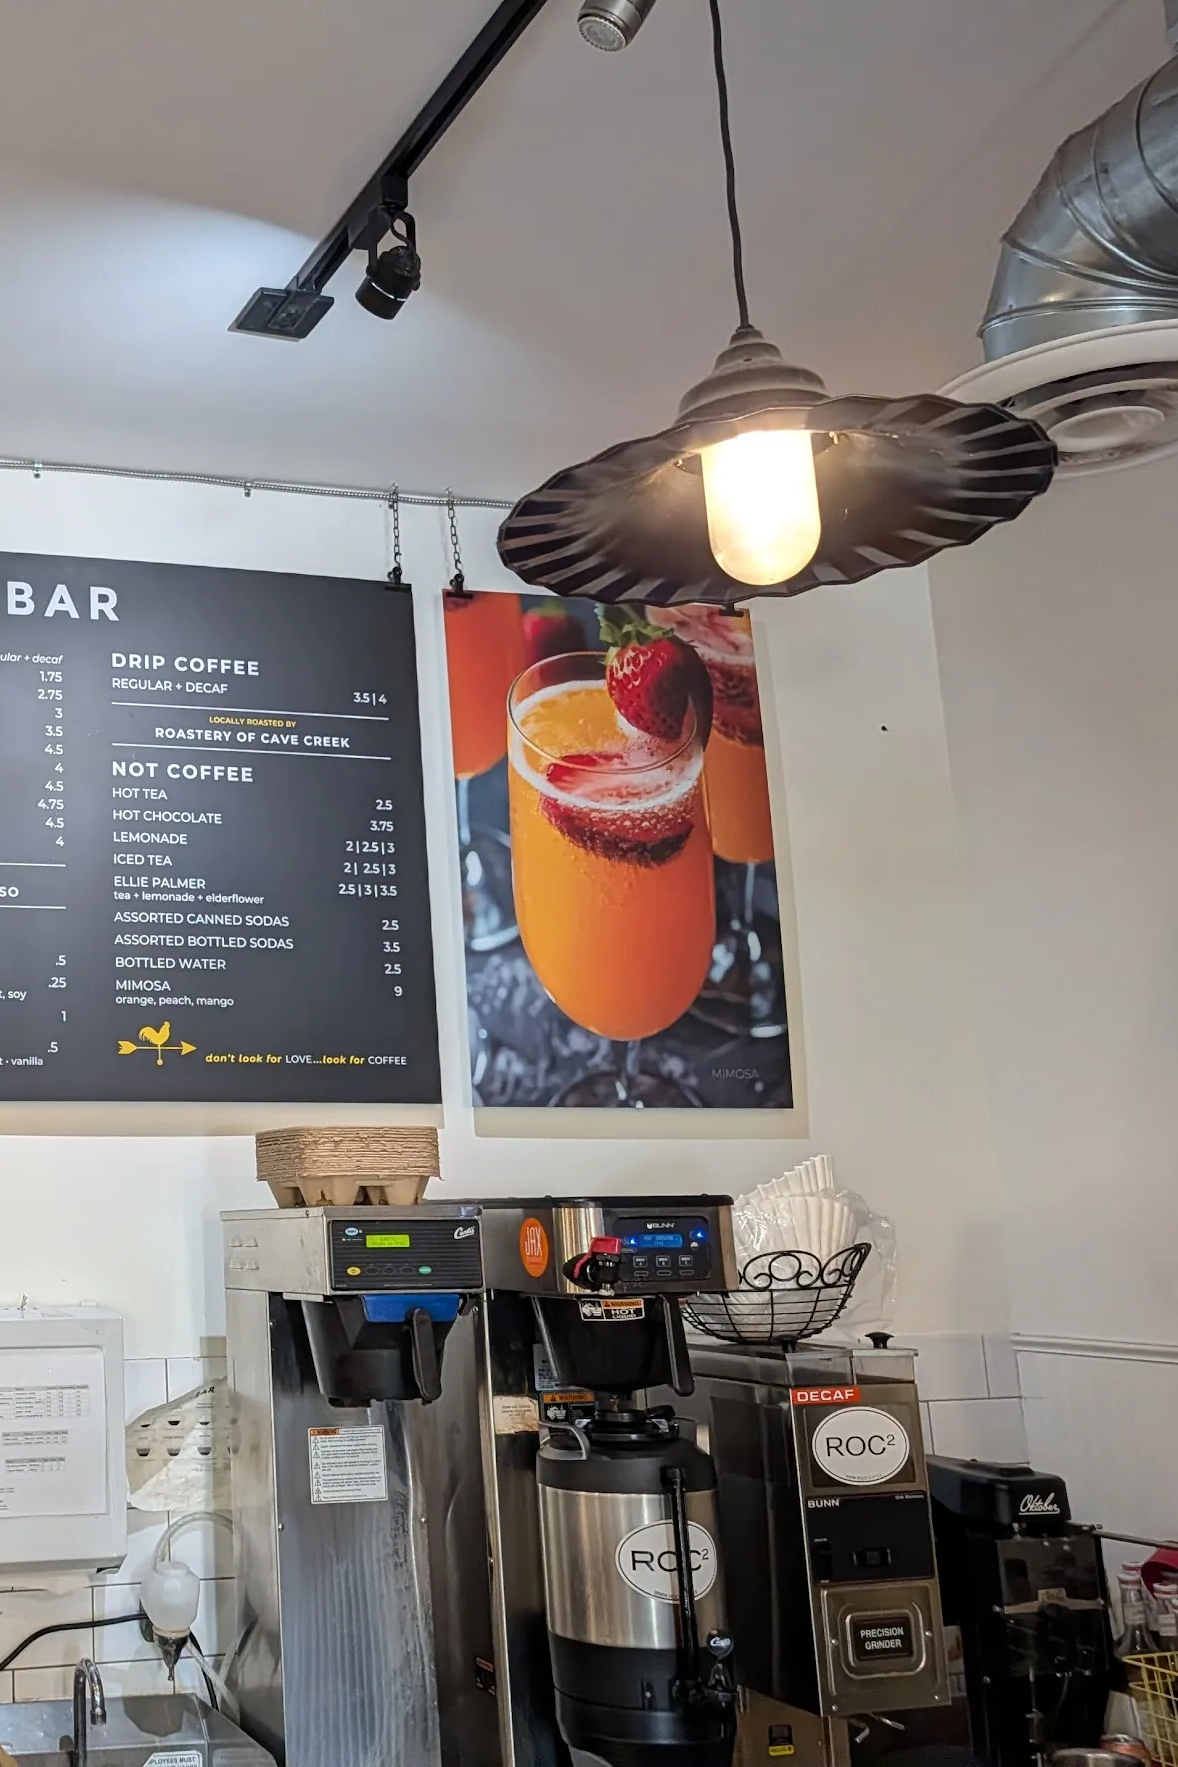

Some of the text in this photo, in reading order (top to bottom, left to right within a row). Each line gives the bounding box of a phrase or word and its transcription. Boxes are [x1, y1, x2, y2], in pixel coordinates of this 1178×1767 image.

[32, 654, 63, 664] decaf
[112, 653, 259, 675] DRIP COFFEE
[40, 671, 62, 682] 1.75
[112, 678, 172, 691] REGULAR
[186, 682, 228, 694] DECAF
[38, 689, 62, 700] 2.75
[55, 708, 62, 718] 3
[247, 719, 284, 727] ROASTED
[46, 726, 63, 736] 3.5
[156, 728, 350, 748] ROASTERY OF CAVE CREEK
[45, 744, 63, 754] 4.5
[55, 763, 63, 773] 4
[113, 761, 252, 782] NOT COFFEE
[45, 781, 63, 791] 4.5
[113, 788, 167, 800] HOT TEA
[38, 799, 64, 809] 4.75
[376, 800, 392, 810] 2.5
[113, 810, 222, 824] HOT CHOCOLATE
[46, 818, 64, 828] 4.5
[370, 820, 393, 831] 3.75
[56, 836, 64, 846] 4
[114, 832, 187, 844] LEMONADE
[114, 854, 172, 866] ICED TEA
[114, 876, 205, 889] ELLIE PALMER
[114, 891, 130, 899] tea
[142, 891, 194, 902] lemonade
[206, 893, 264, 904] elderflower
[114, 912, 289, 926] ASSORTED CANNED SODAS
[382, 920, 399, 930] 2.5
[114, 934, 293, 949] ASSORTED BOTTLED SODAS
[384, 942, 400, 952] 3.5
[56, 955, 66, 965] .5
[116, 957, 226, 969] BOTTLED WATER
[385, 964, 401, 974] 2.5
[49, 977, 66, 988] .25
[116, 980, 171, 991] MIMOSA
[8, 991, 26, 1000] soy
[394, 986, 402, 996] 9
[116, 996, 234, 1007] orange, peach, mango
[62, 1011, 66, 1021] 1
[48, 1042, 58, 1052] .5
[11, 1057, 43, 1065] vanilla
[206, 1054, 235, 1062] don't
[239, 1054, 262, 1062] look
[266, 1054, 282, 1063] for
[350, 1056, 364, 1064] for
[368, 1056, 406, 1065] COFFEE
[711, 1068, 759, 1079] MIMOSA
[525, 1226, 543, 1256] JAX
[797, 1389, 854, 1402] DECAF
[807, 1499, 840, 1509] BUNN
[1019, 1492, 1061, 1515] Oktober
[860, 1627, 904, 1638] PRECISION
[864, 1638, 902, 1650] GRINDER
